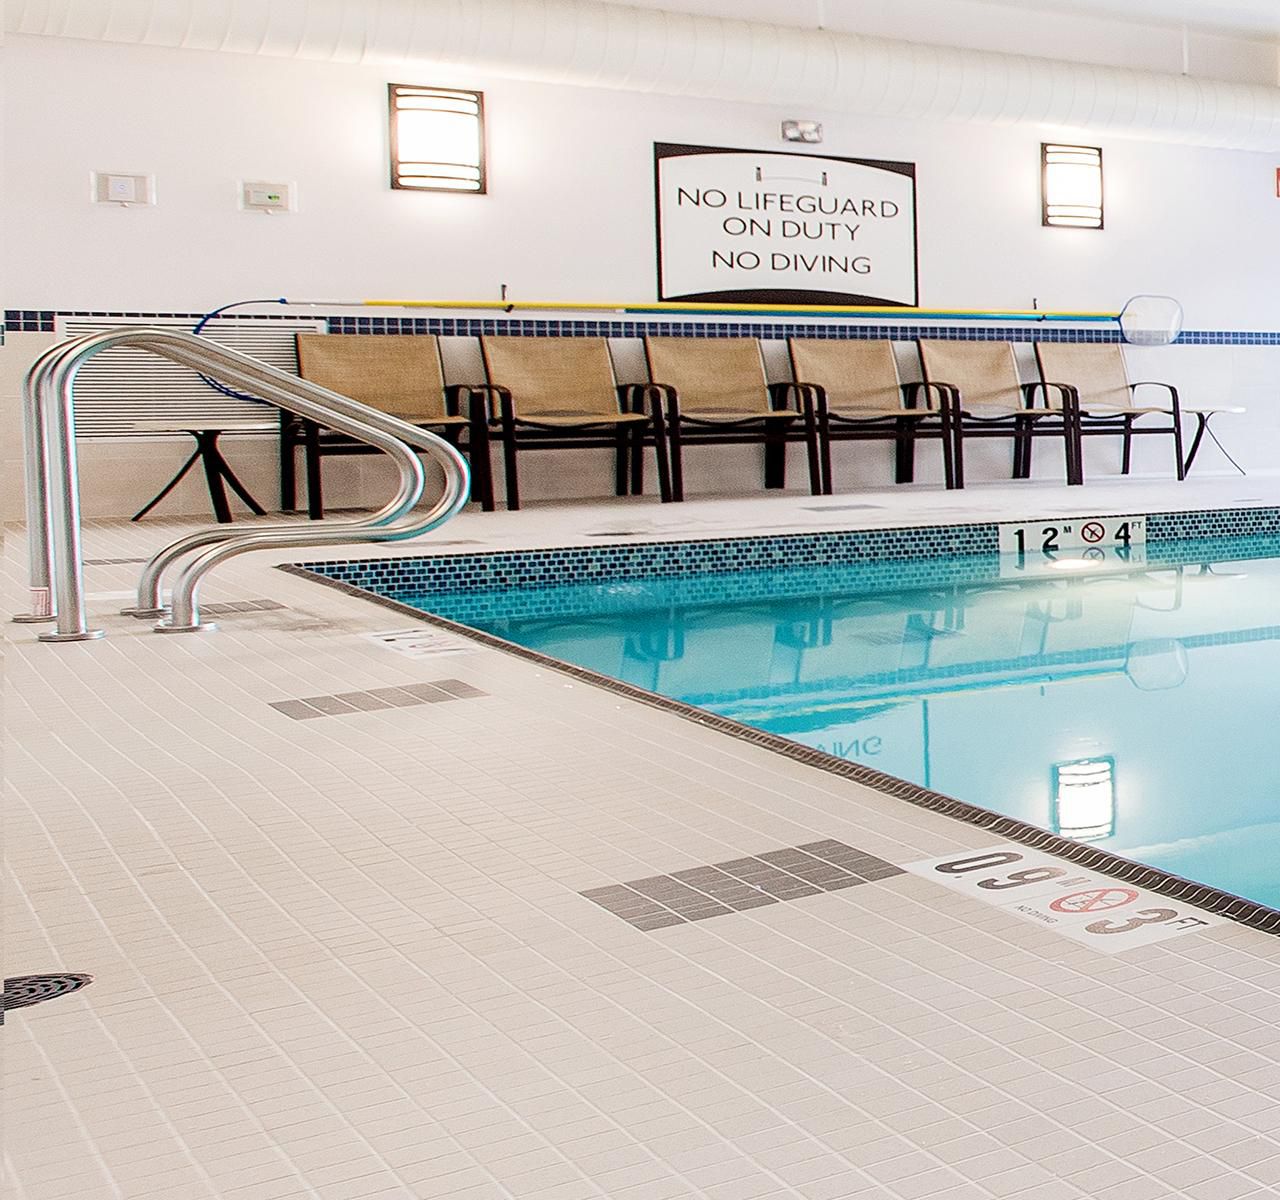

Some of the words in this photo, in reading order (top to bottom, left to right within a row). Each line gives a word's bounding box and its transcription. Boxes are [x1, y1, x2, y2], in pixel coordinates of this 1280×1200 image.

[677, 187, 727, 208] NO
[738, 191, 899, 218] LIFEGUARD
[723, 217, 771, 237] ON
[782, 220, 861, 241] DUTY
[712, 251, 760, 270] NO
[771, 253, 871, 274] DIVING
[1114, 522, 1131, 547] 4
[1131, 521, 1142, 529] FT
[1084, 908, 1178, 934] 3
[1164, 917, 1209, 930] FT
